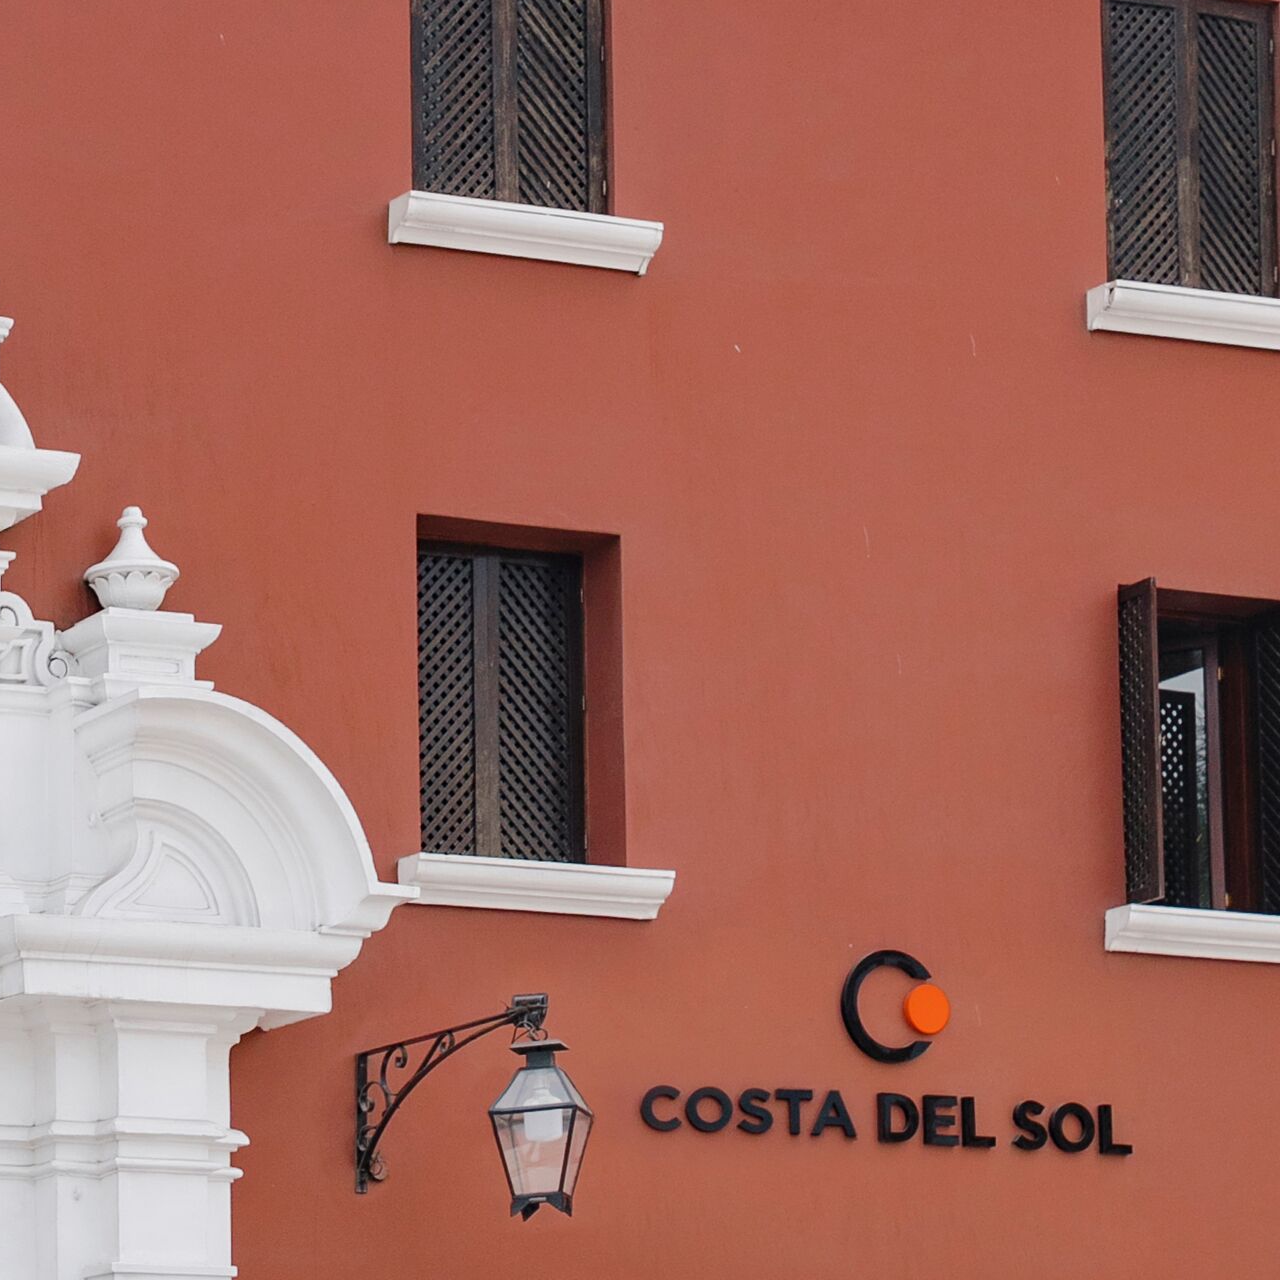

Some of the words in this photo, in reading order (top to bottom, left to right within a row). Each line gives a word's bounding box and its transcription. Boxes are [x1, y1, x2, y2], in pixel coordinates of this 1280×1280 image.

[640, 1085, 857, 1139] COSTA
[877, 1092, 996, 1148] DEL
[1013, 1100, 1133, 1156] SOL
